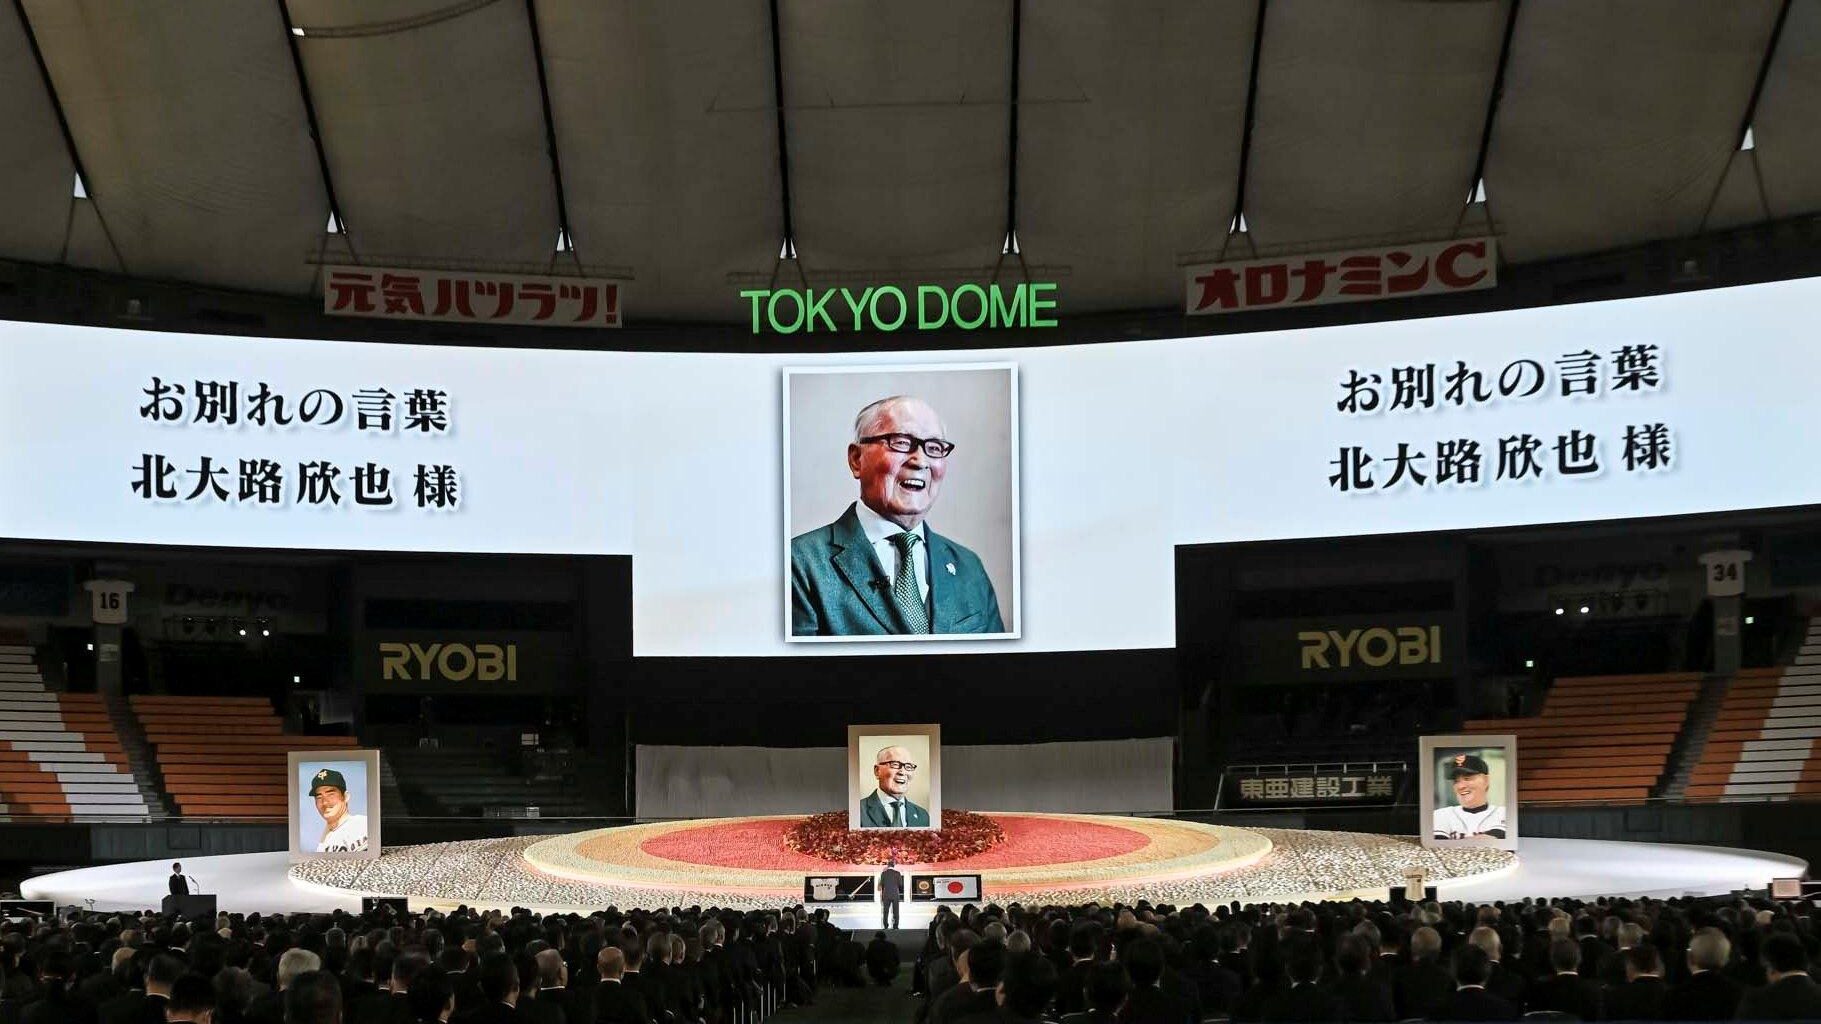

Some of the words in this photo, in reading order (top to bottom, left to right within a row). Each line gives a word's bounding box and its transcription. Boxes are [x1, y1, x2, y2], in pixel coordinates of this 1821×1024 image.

[1194, 242, 1488, 312] オロナミンC
[740, 285, 907, 334] TOKYO
[917, 282, 1058, 330] DOME
[1337, 344, 1661, 414] お別れの言葉
[139, 376, 448, 433] お別れの言葉
[1712, 563, 1738, 582] 34
[99, 591, 120, 610] 16
[379, 642, 518, 681] RYOBI
[1298, 625, 1442, 669] RYOBI
[1239, 775, 1393, 800] 東亜建設工業
